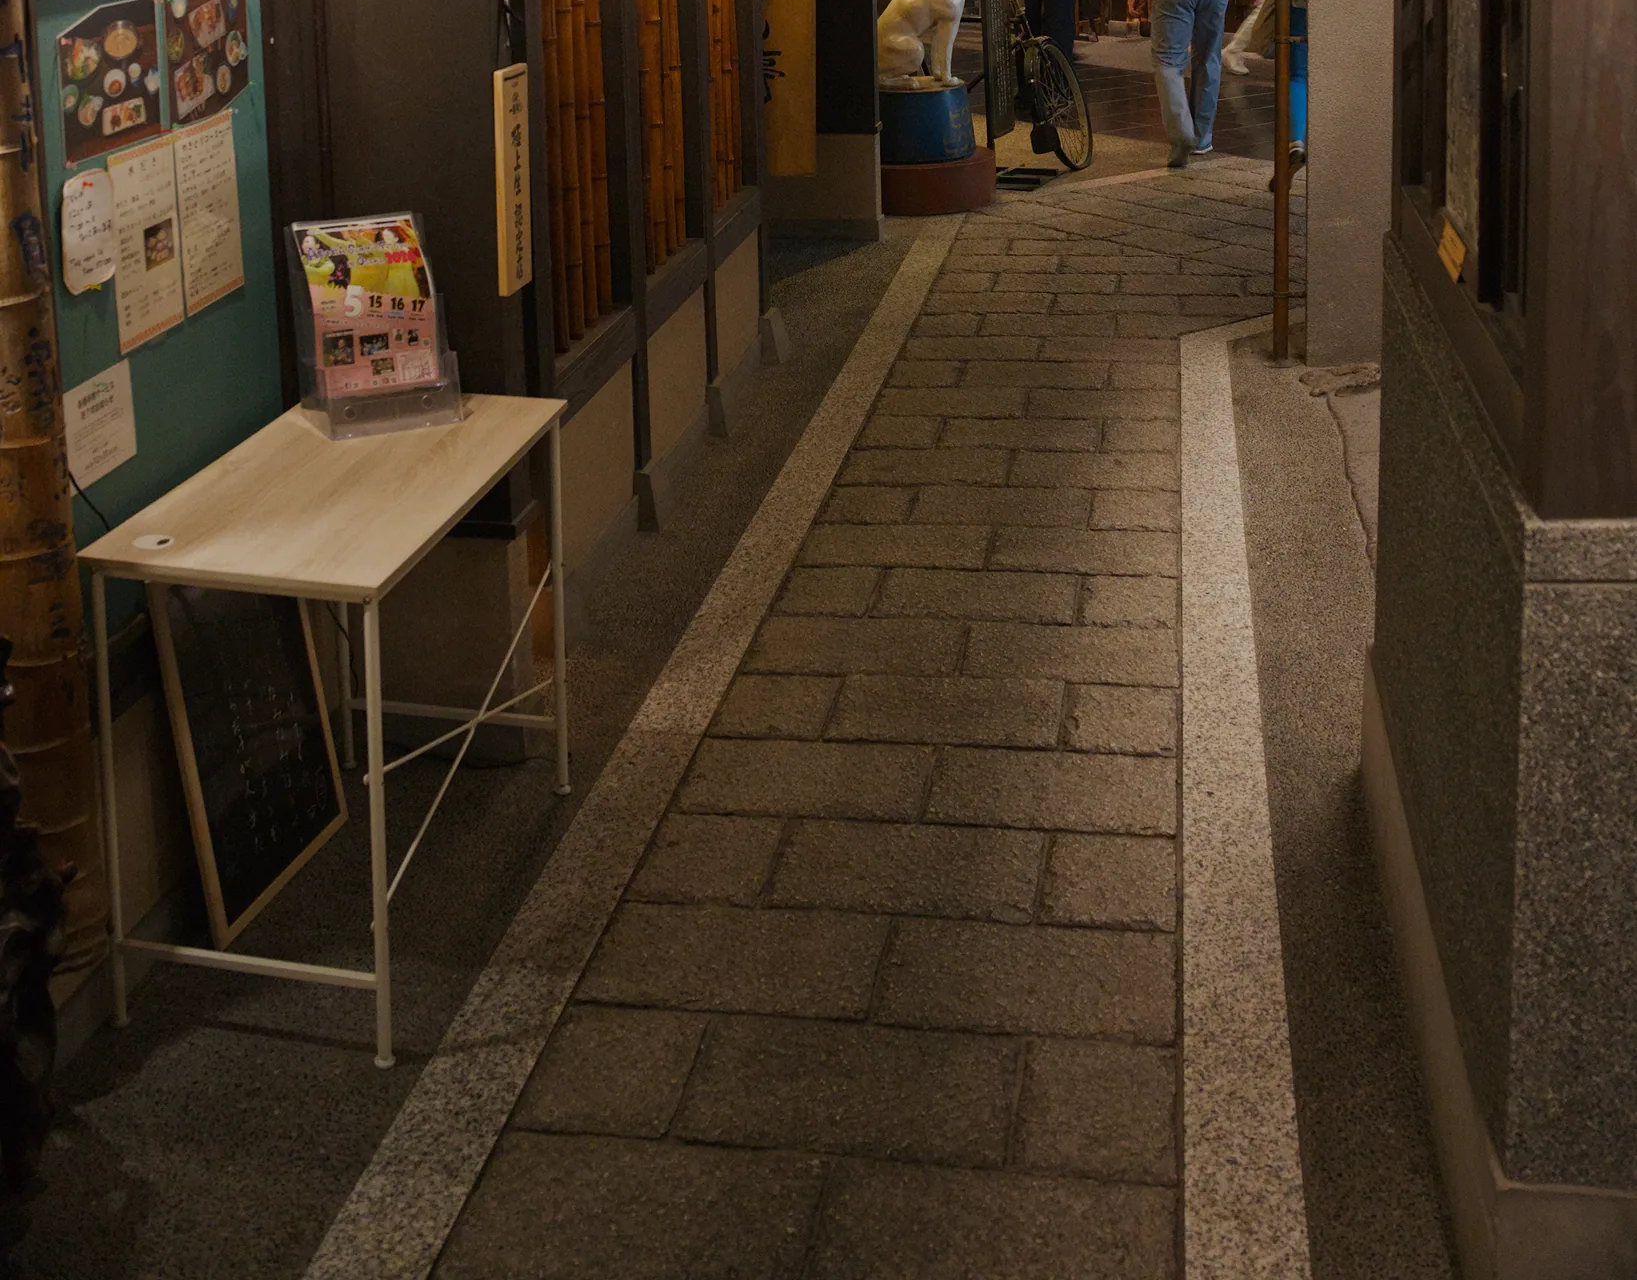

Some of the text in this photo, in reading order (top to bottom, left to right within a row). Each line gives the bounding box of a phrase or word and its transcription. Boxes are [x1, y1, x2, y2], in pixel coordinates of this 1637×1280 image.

[344, 284, 364, 318] 5
[369, 294, 383, 309] 15
[390, 296, 405, 311] 16
[411, 299, 426, 313] 17
